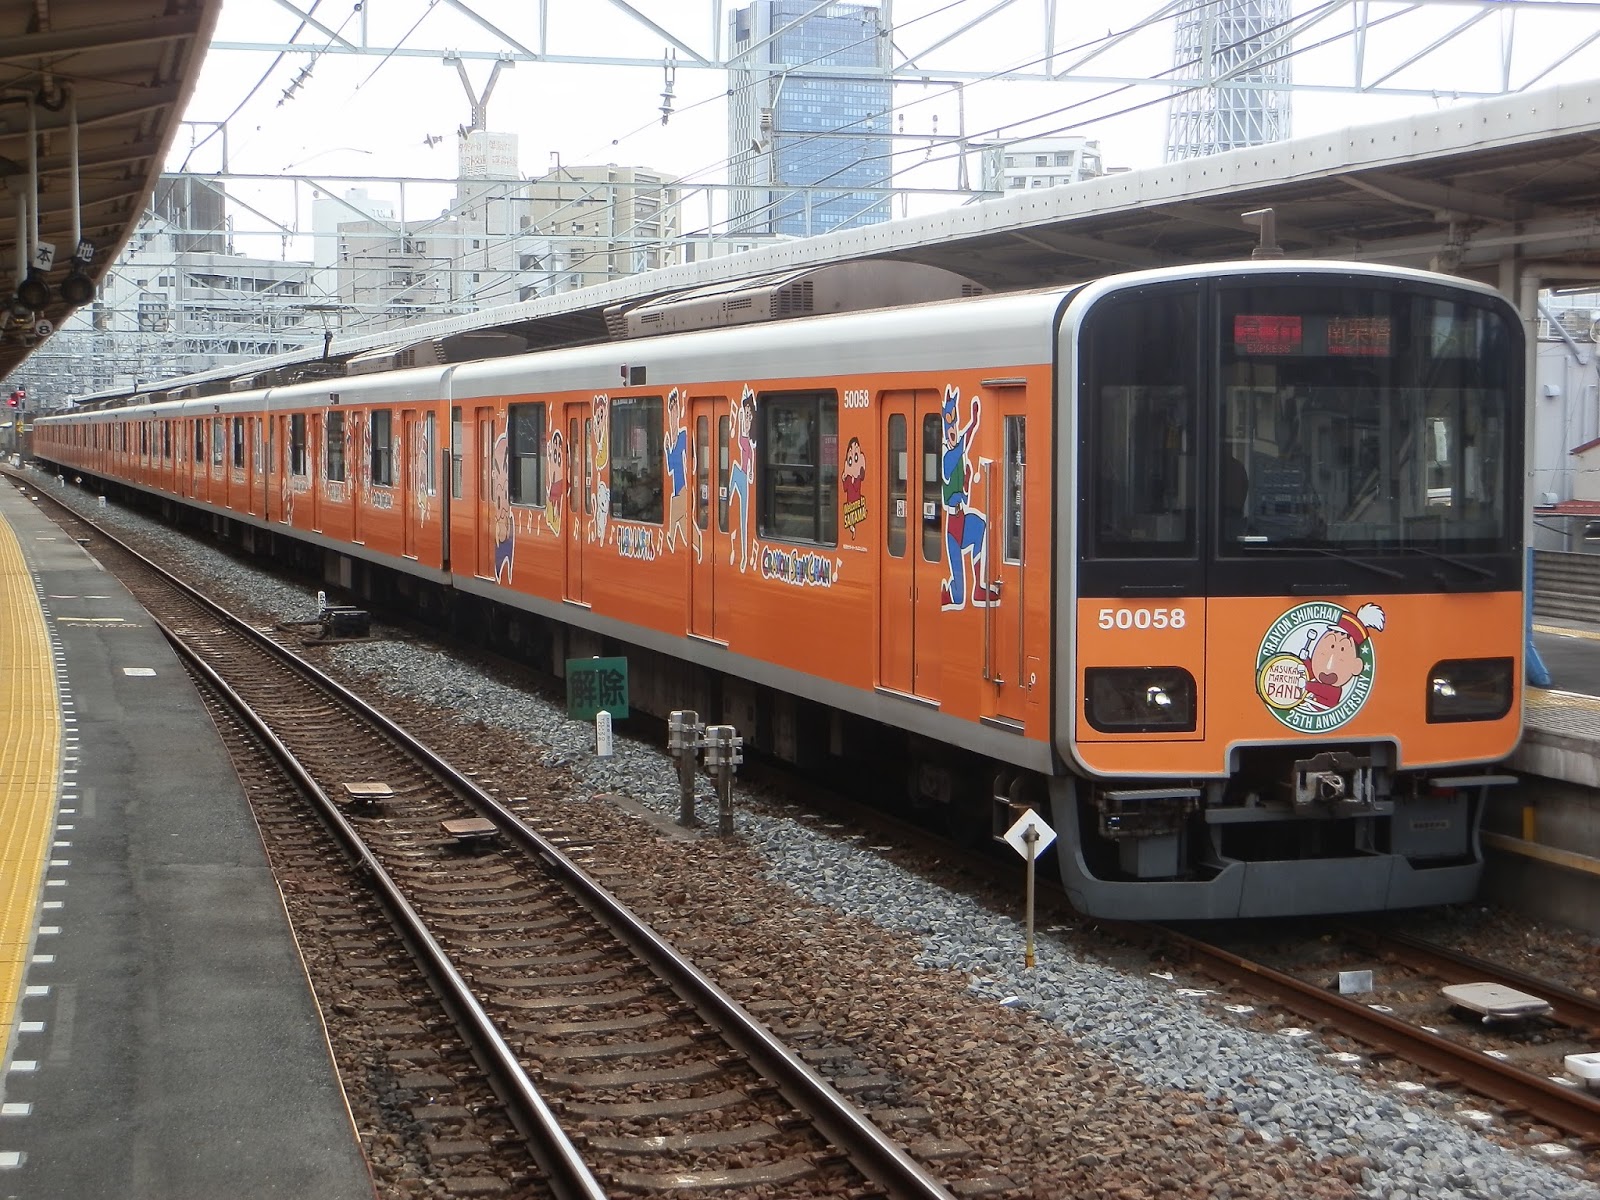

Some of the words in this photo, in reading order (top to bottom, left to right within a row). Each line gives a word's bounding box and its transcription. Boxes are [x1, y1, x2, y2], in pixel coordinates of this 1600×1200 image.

[36, 248, 52, 265] 本
[77, 242, 94, 262] 地
[39, 325, 50, 334] 8
[844, 390, 870, 408] 50058
[1098, 608, 1185, 629] 50058
[1263, 618, 1293, 656] CRAYON
[1292, 606, 1340, 624] SHINCHAN
[571, 669, 625, 708] 解除
[1267, 683, 1303, 699] BAND
[1286, 711, 1313, 729] 25TH
[1316, 675, 1370, 729] ANNIVERSARY
